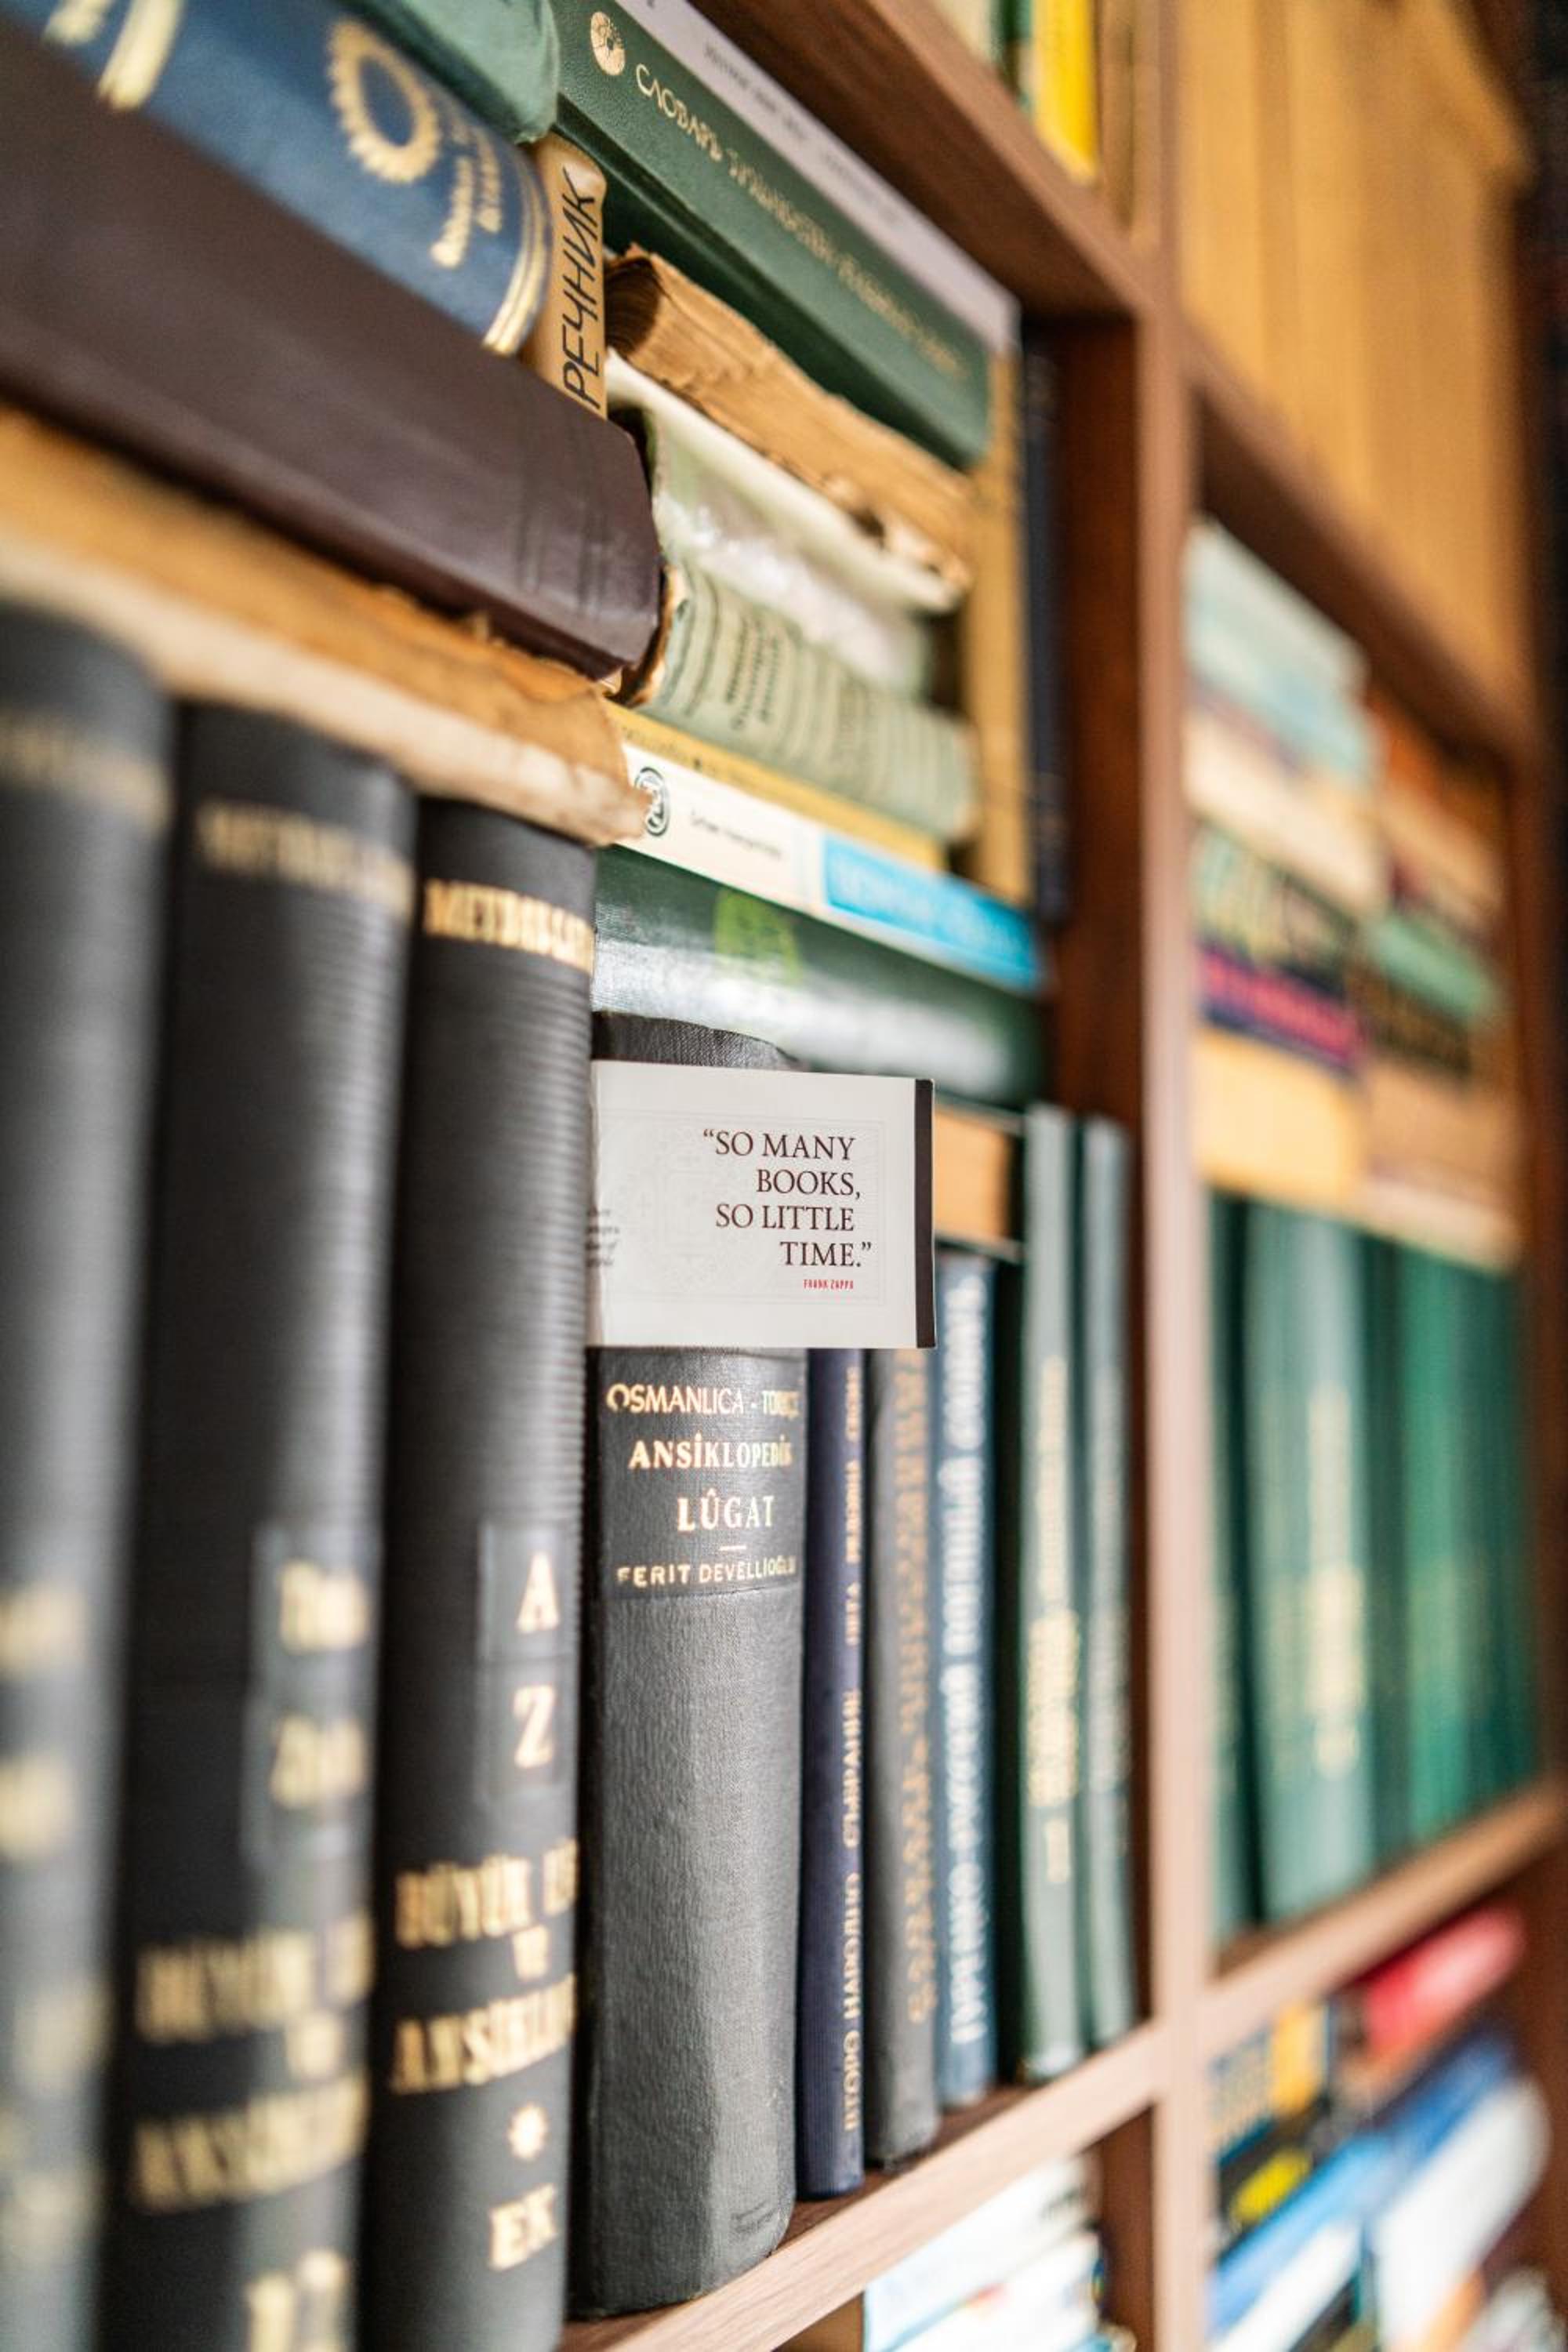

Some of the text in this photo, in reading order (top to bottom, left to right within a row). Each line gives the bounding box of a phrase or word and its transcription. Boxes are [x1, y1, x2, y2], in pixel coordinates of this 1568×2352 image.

[562, 166, 601, 409] РЕЧНИК
[702, 1129, 855, 1161] “SO MANY
[755, 1169, 862, 1200] BOOKS,
[716, 1203, 855, 1232] SO LITTLE
[779, 1241, 872, 1267] TIME.”
[803, 1279, 854, 1290] FRANK ZAPPA
[606, 1383, 744, 1414] OSMANLICA
[516, 1551, 561, 1635] A
[512, 1684, 556, 1769] Z
[488, 2184, 557, 2270] EK
